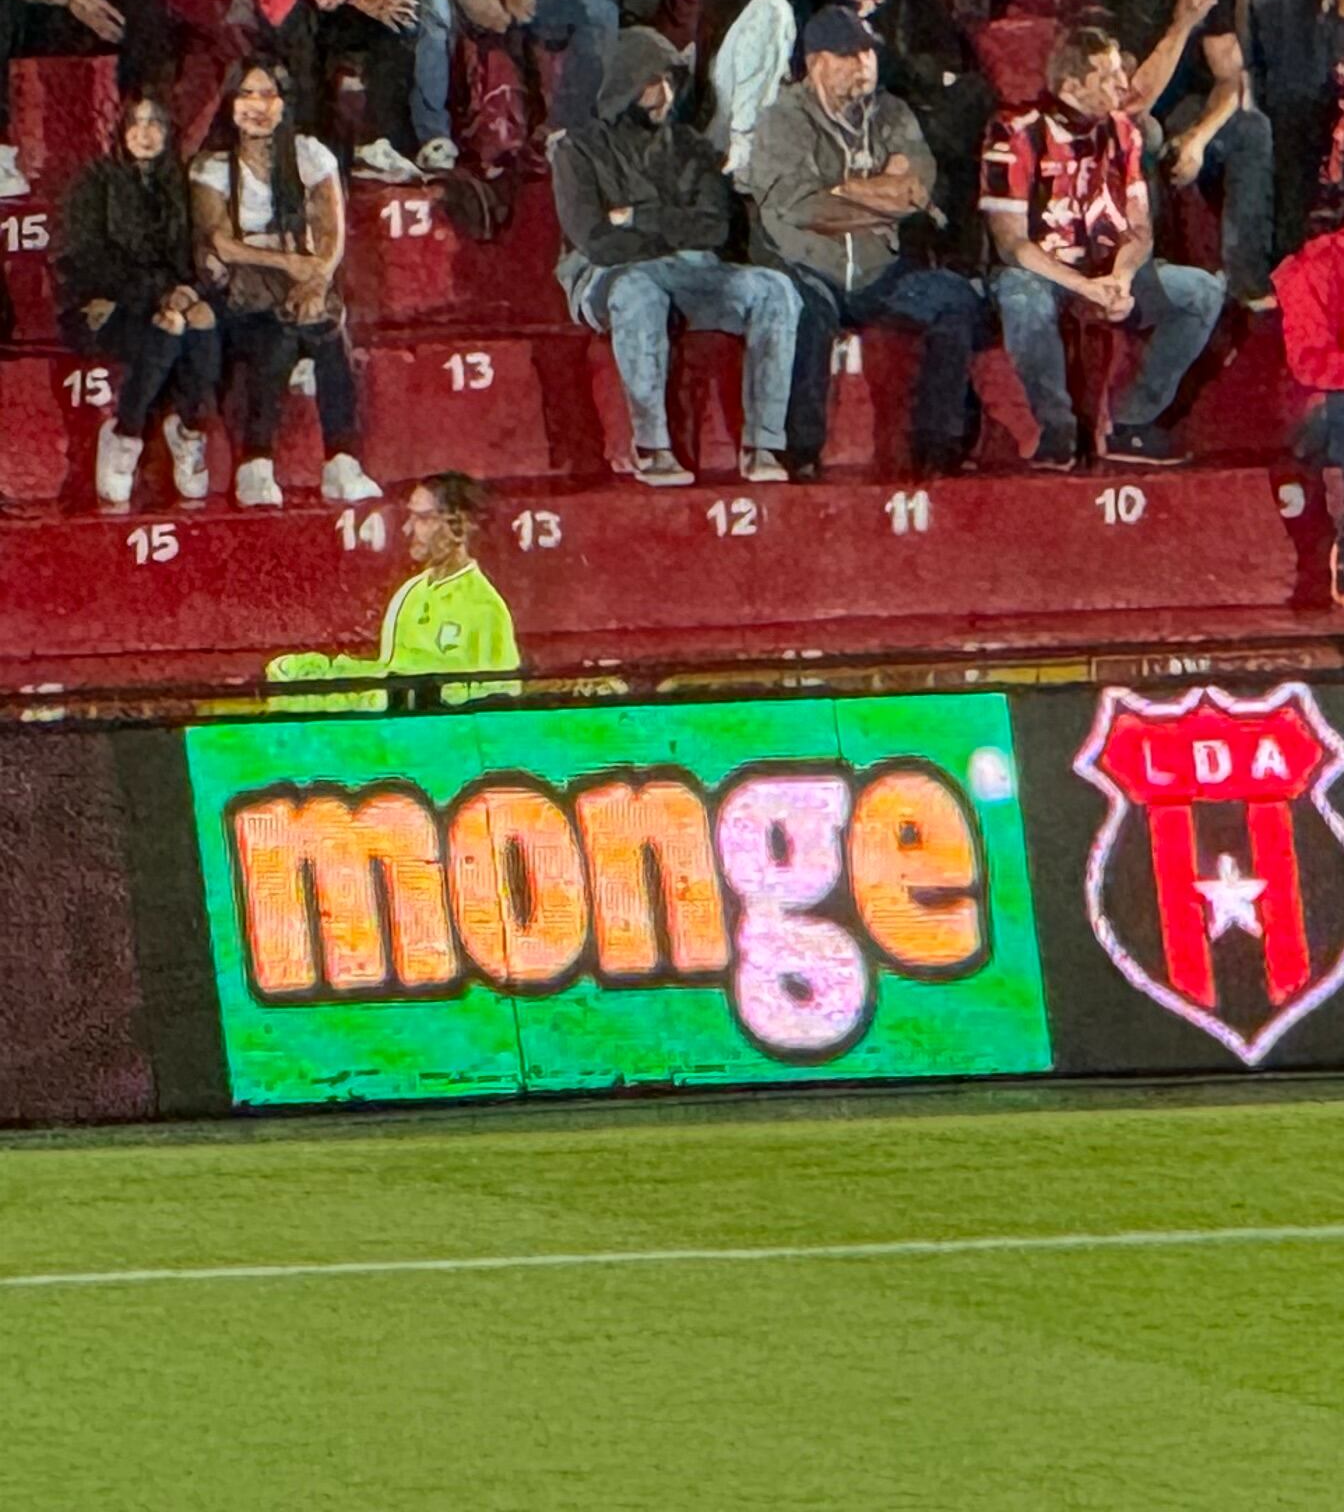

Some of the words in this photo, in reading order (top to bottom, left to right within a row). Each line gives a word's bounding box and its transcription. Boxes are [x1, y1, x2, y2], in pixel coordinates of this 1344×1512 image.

[0, 212, 50, 253] 15
[380, 199, 433, 239] 13
[63, 367, 113, 408] 15
[443, 352, 495, 392] 13
[705, 497, 758, 538] 12
[884, 488, 930, 536] 11
[1095, 485, 1146, 525] 10
[126, 524, 180, 566] 15
[335, 509, 387, 552] 14
[511, 509, 563, 552] 13
[1142, 734, 1292, 786] LDA
[227, 757, 989, 1062] monge
